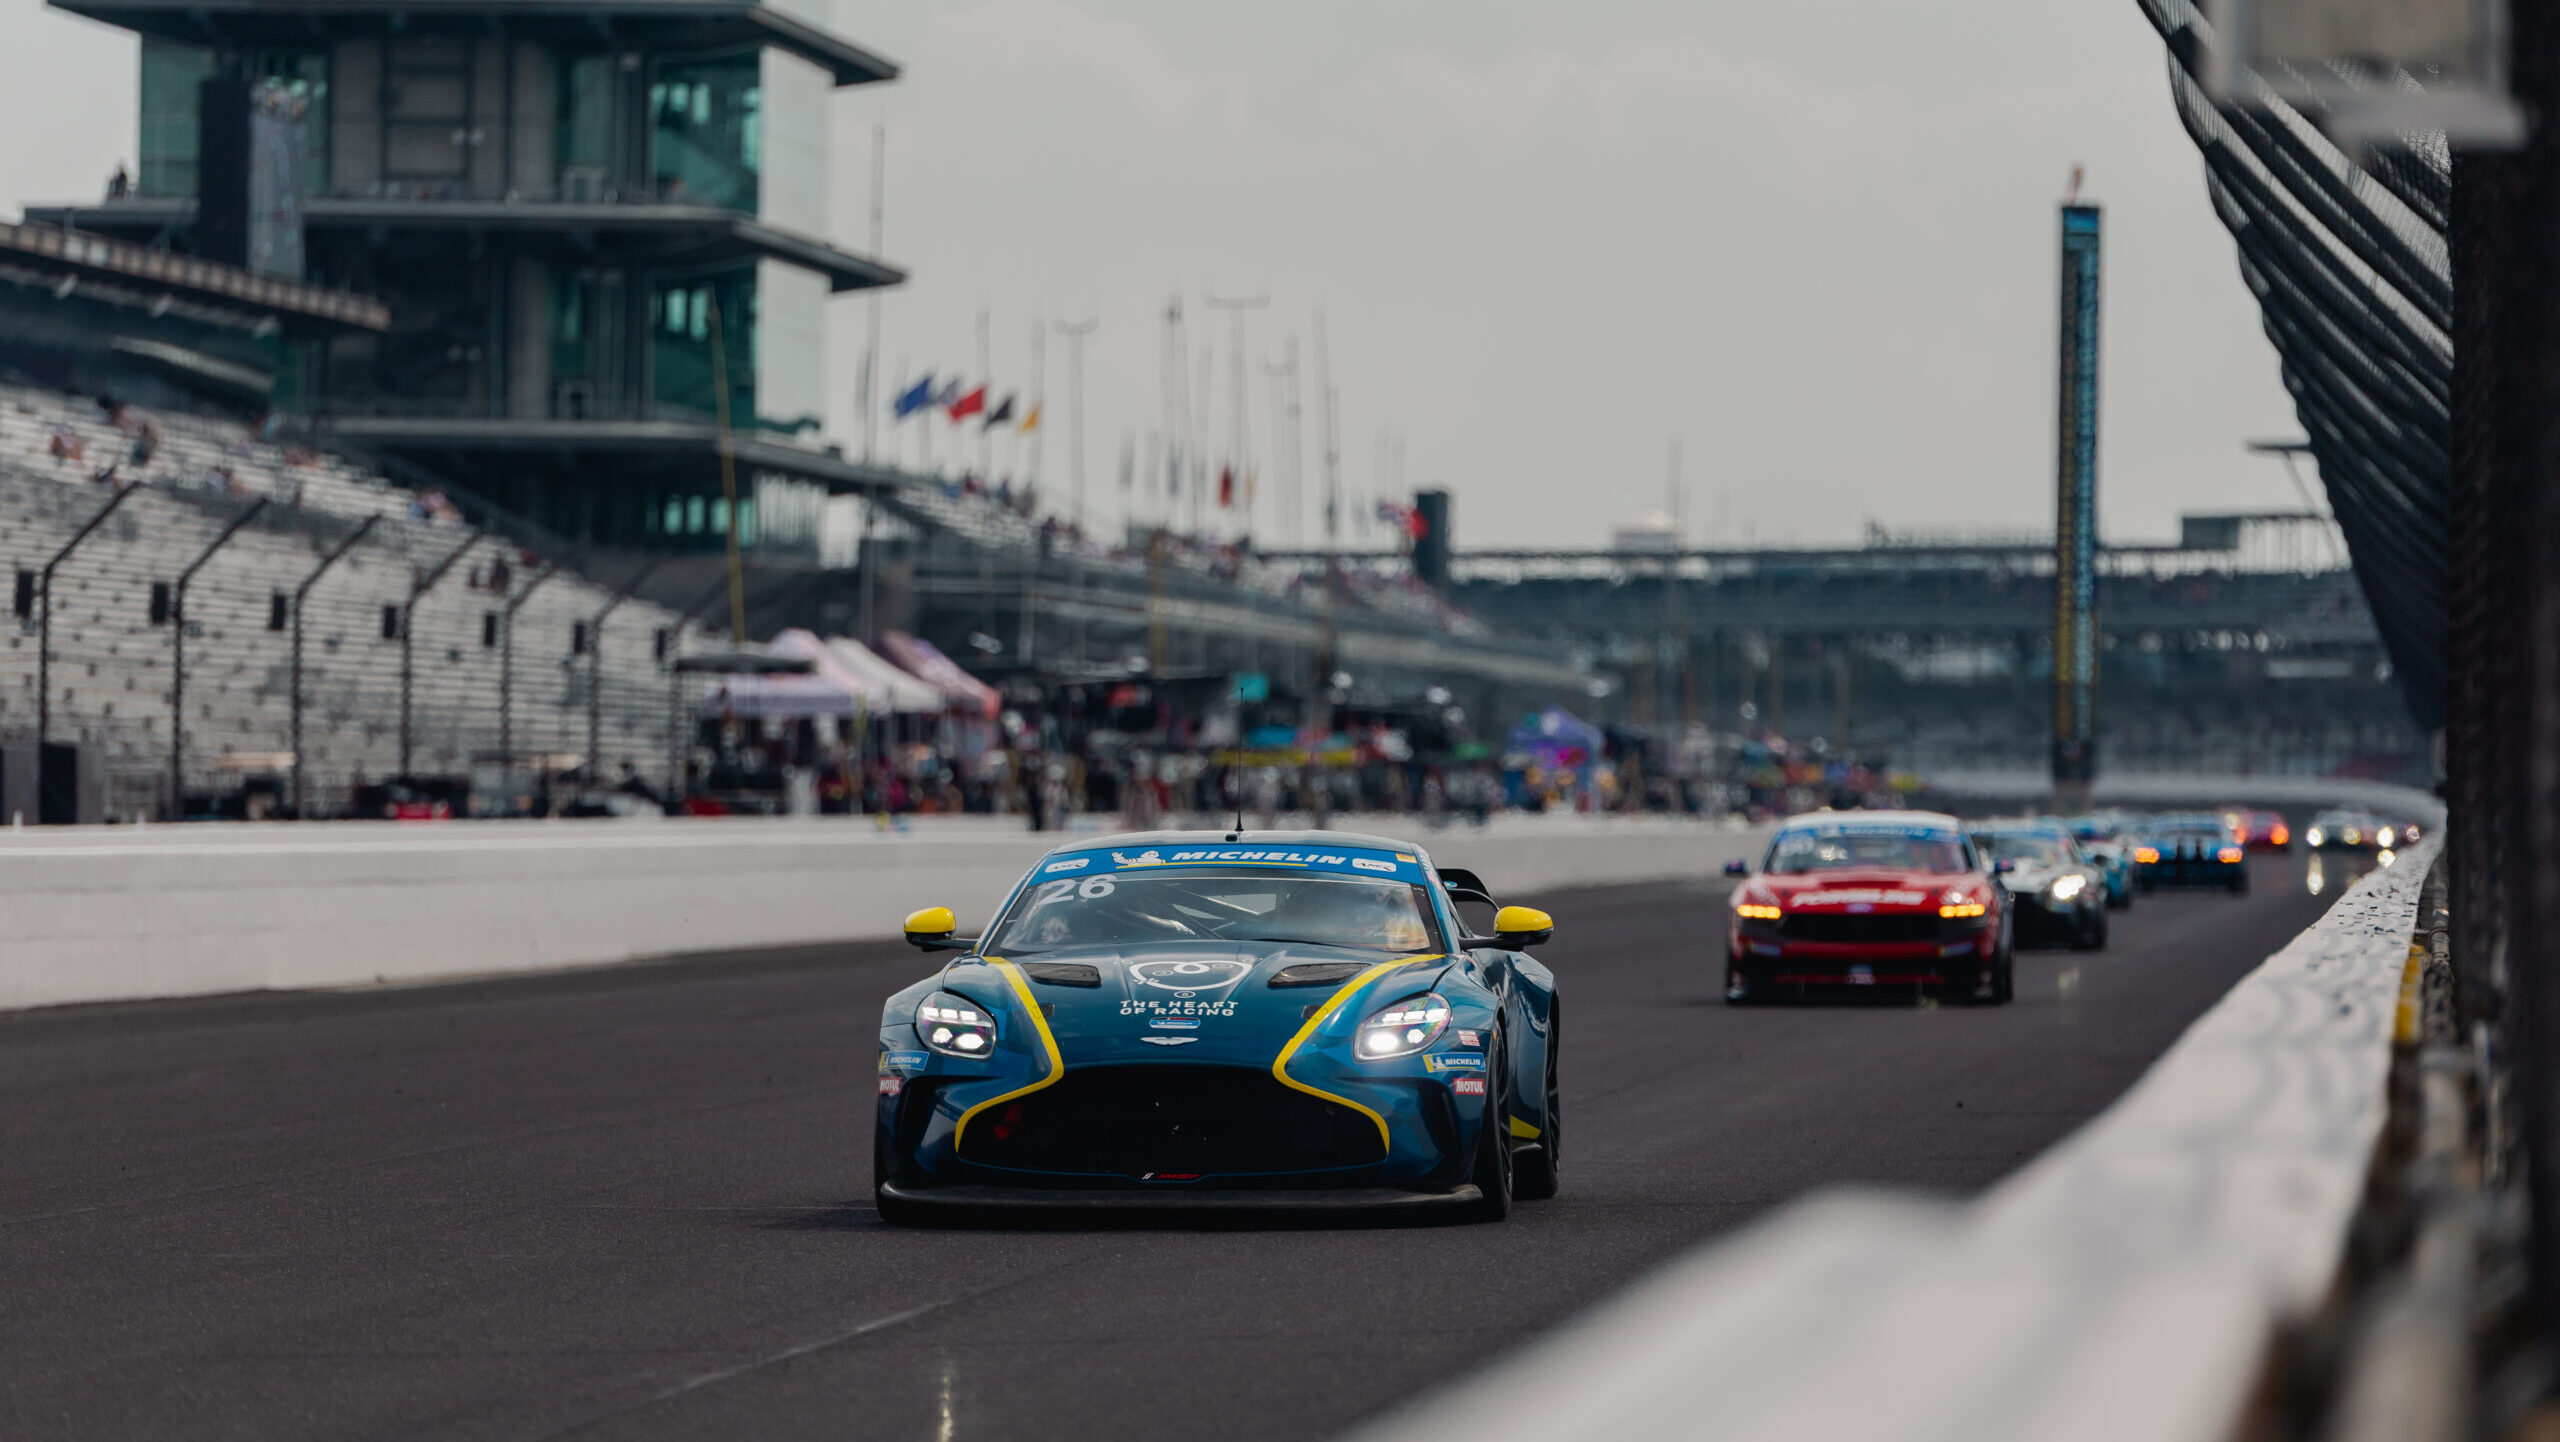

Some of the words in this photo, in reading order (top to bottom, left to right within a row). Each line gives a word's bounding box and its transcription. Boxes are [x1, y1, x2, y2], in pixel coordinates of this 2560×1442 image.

[1171, 850, 1347, 865] MICHELIN
[1038, 873, 1118, 905] 26
[1120, 1000, 1160, 1008] THE
[1169, 1001, 1239, 1009] HEART
[1120, 1007, 1146, 1015] OF
[1154, 1008, 1234, 1016] RACING
[1445, 1058, 1481, 1066] MICHELIN
[1456, 1080, 1484, 1093] MOTUL
